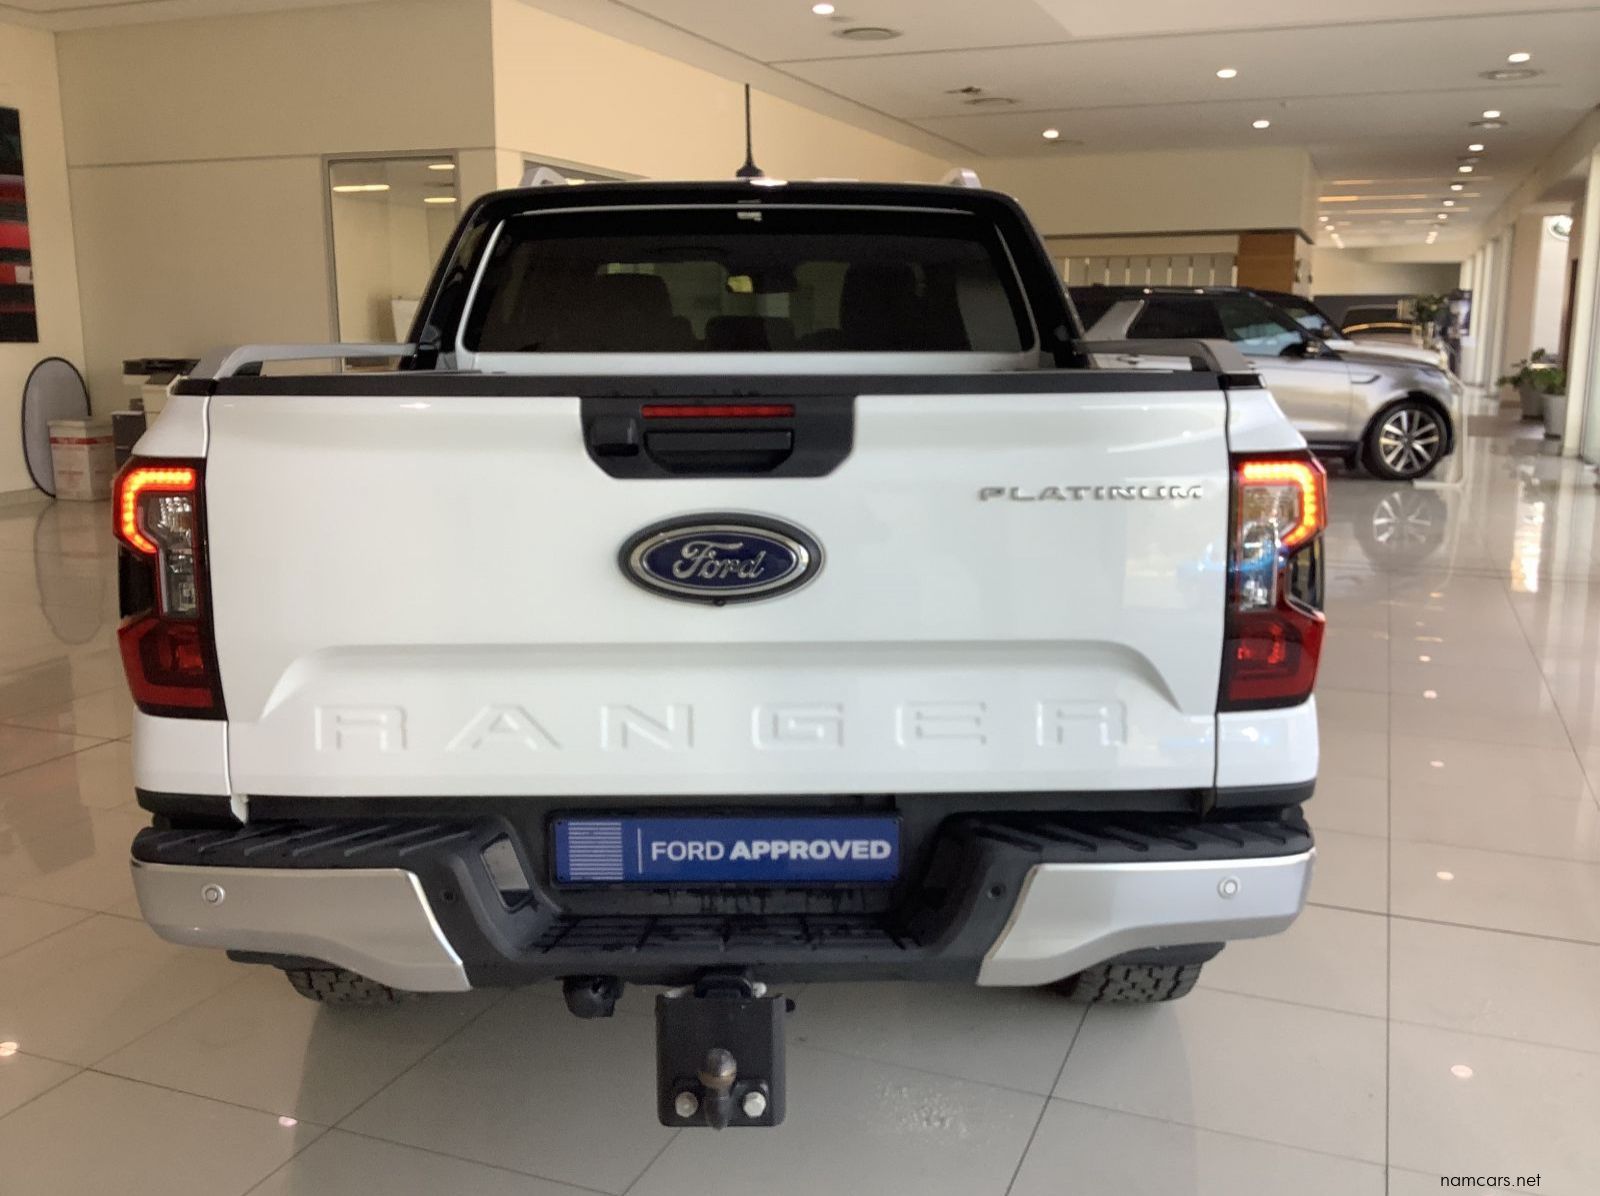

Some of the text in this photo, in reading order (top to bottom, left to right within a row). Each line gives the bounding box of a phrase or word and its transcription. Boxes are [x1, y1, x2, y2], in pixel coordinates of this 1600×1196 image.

[979, 485, 1203, 502] PLATINUM
[672, 540, 767, 579] Ford
[313, 702, 1128, 752] RANGER
[651, 840, 892, 862] FORD APPROVED
